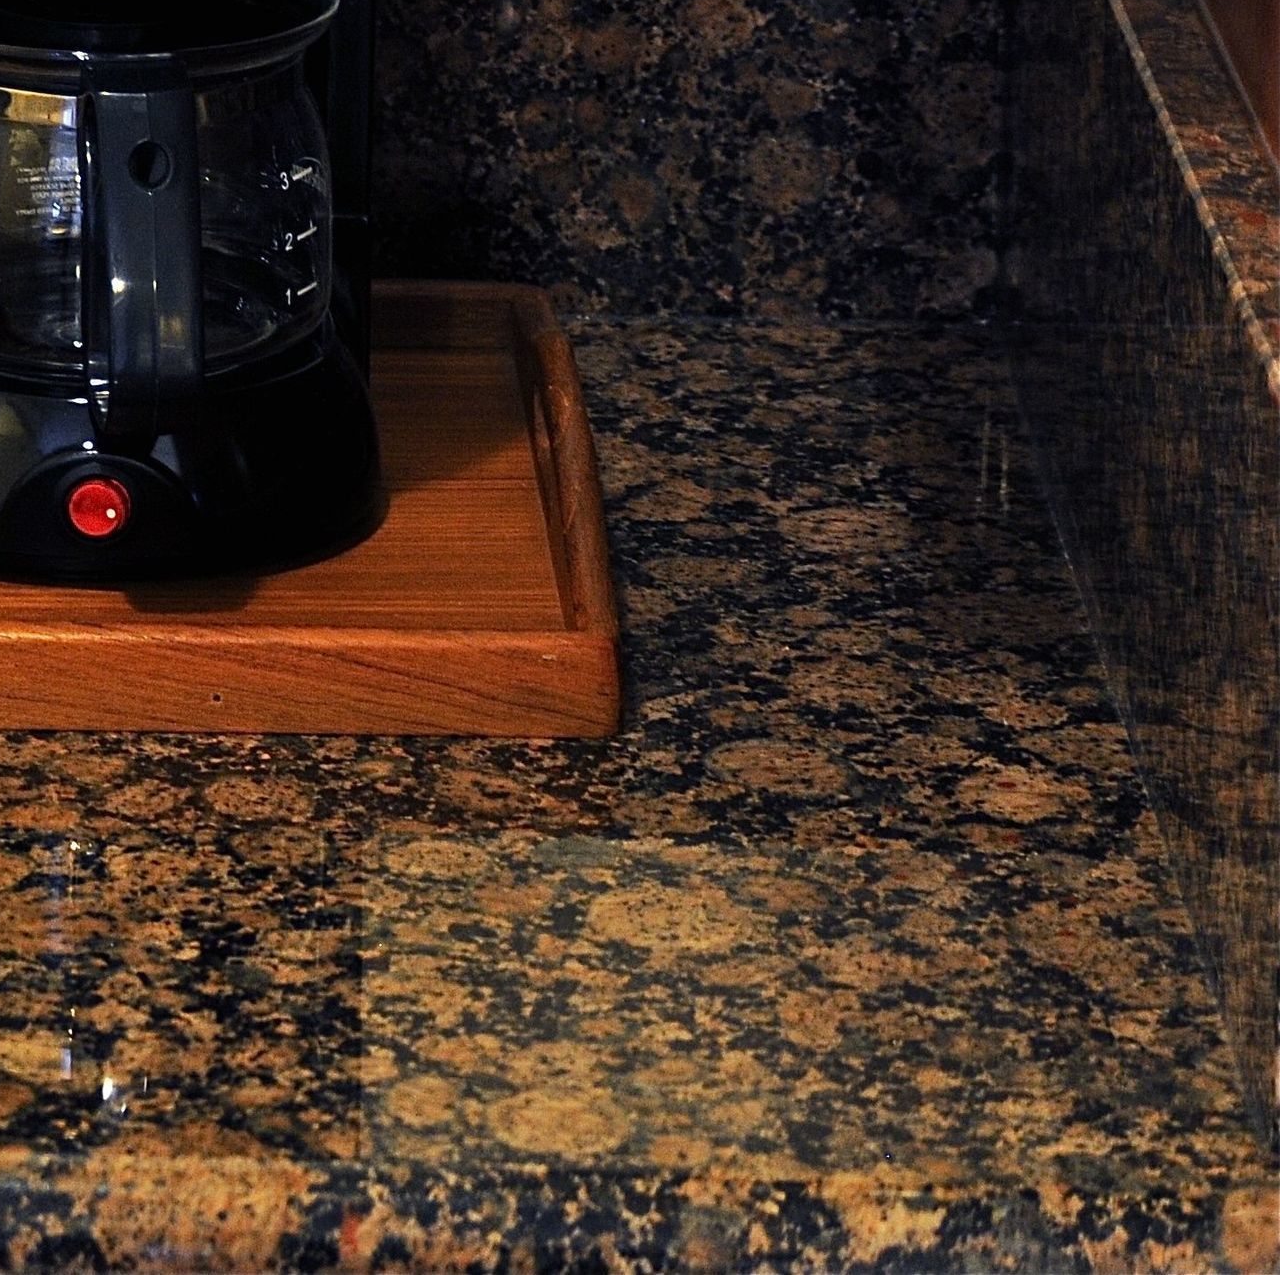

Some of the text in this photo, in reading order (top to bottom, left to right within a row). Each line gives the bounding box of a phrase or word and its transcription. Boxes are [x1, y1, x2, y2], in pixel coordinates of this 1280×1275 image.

[279, 171, 290, 191] 3
[284, 232, 294, 252] 2
[285, 287, 292, 306] 1
